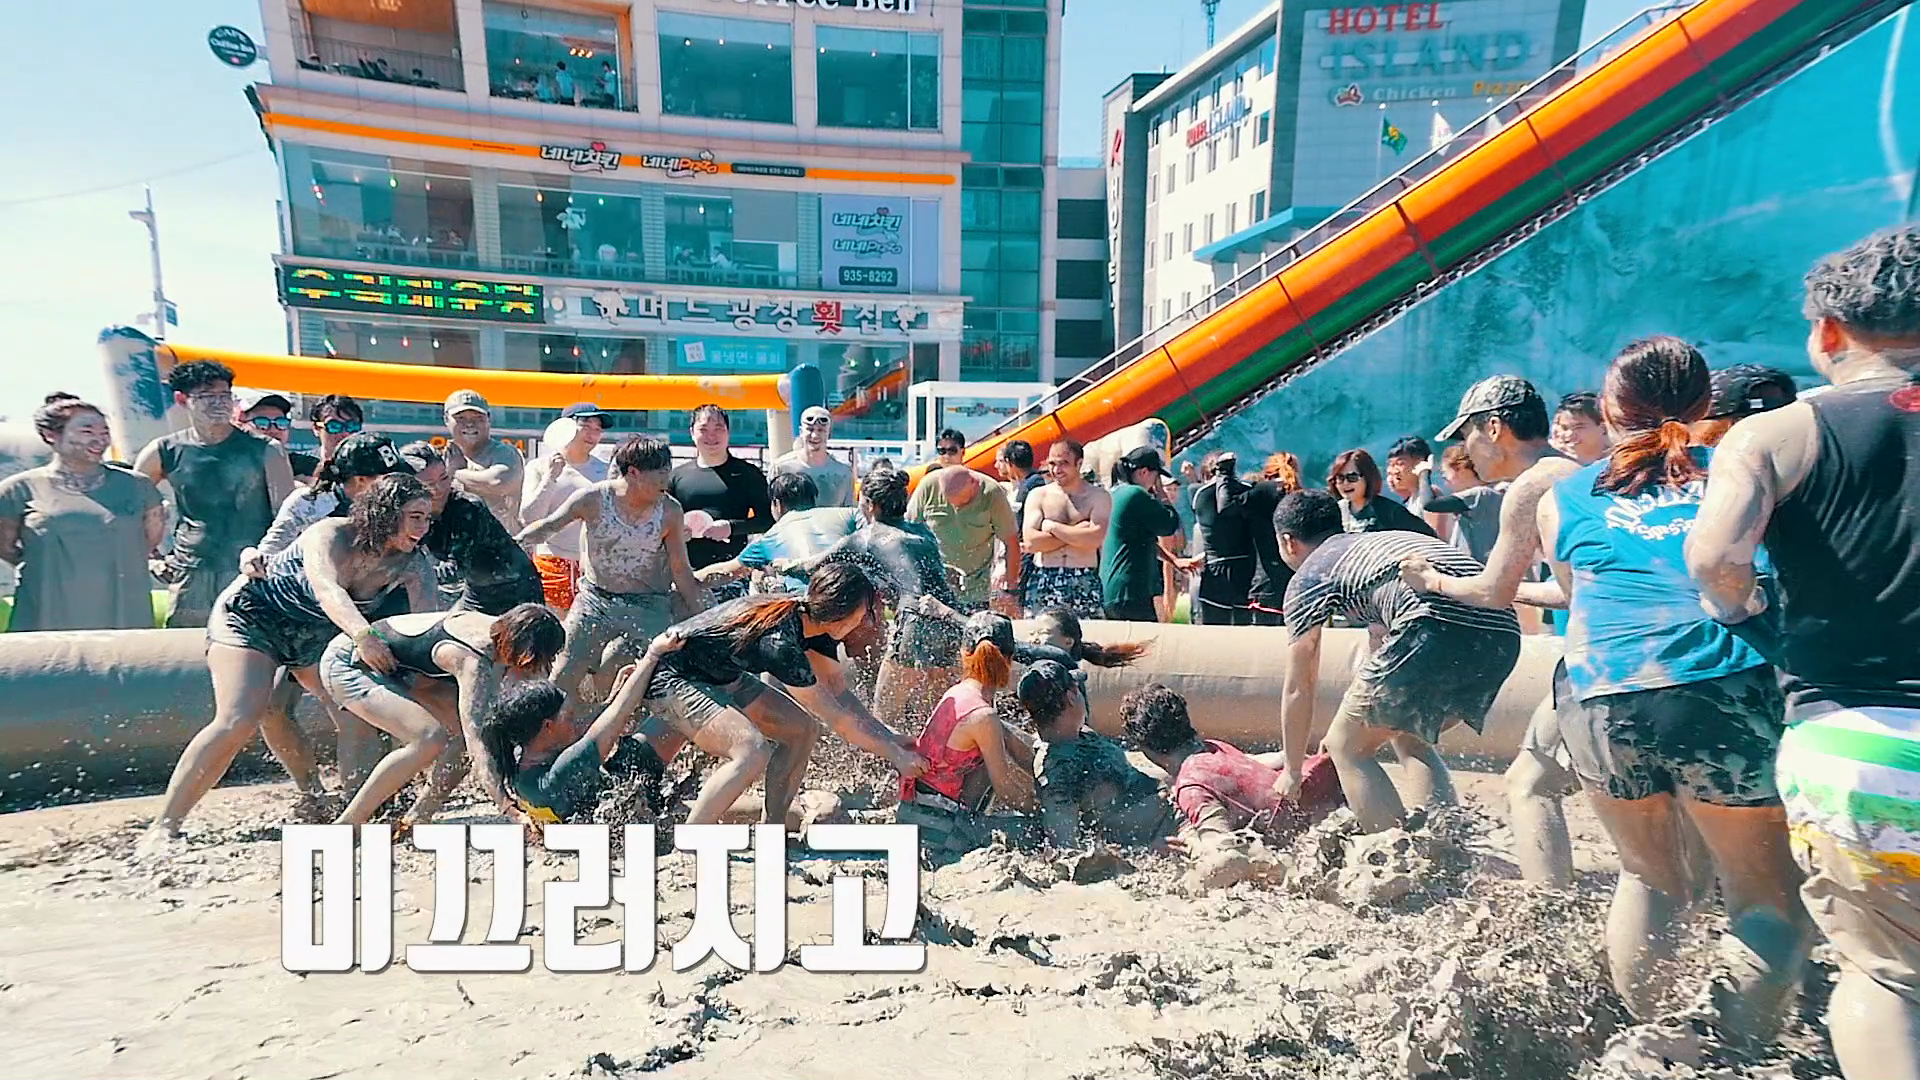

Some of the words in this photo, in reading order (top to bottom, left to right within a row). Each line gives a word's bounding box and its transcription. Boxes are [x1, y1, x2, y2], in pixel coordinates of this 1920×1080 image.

[1328, 3, 1446, 35] HOTEL
[1329, 30, 1531, 80] ISLAND
[1373, 86, 1457, 102] Chicken
[540, 144, 622, 171] 네네치킨
[833, 213, 903, 232] 네네치킨
[843, 269, 894, 283] 935-8292
